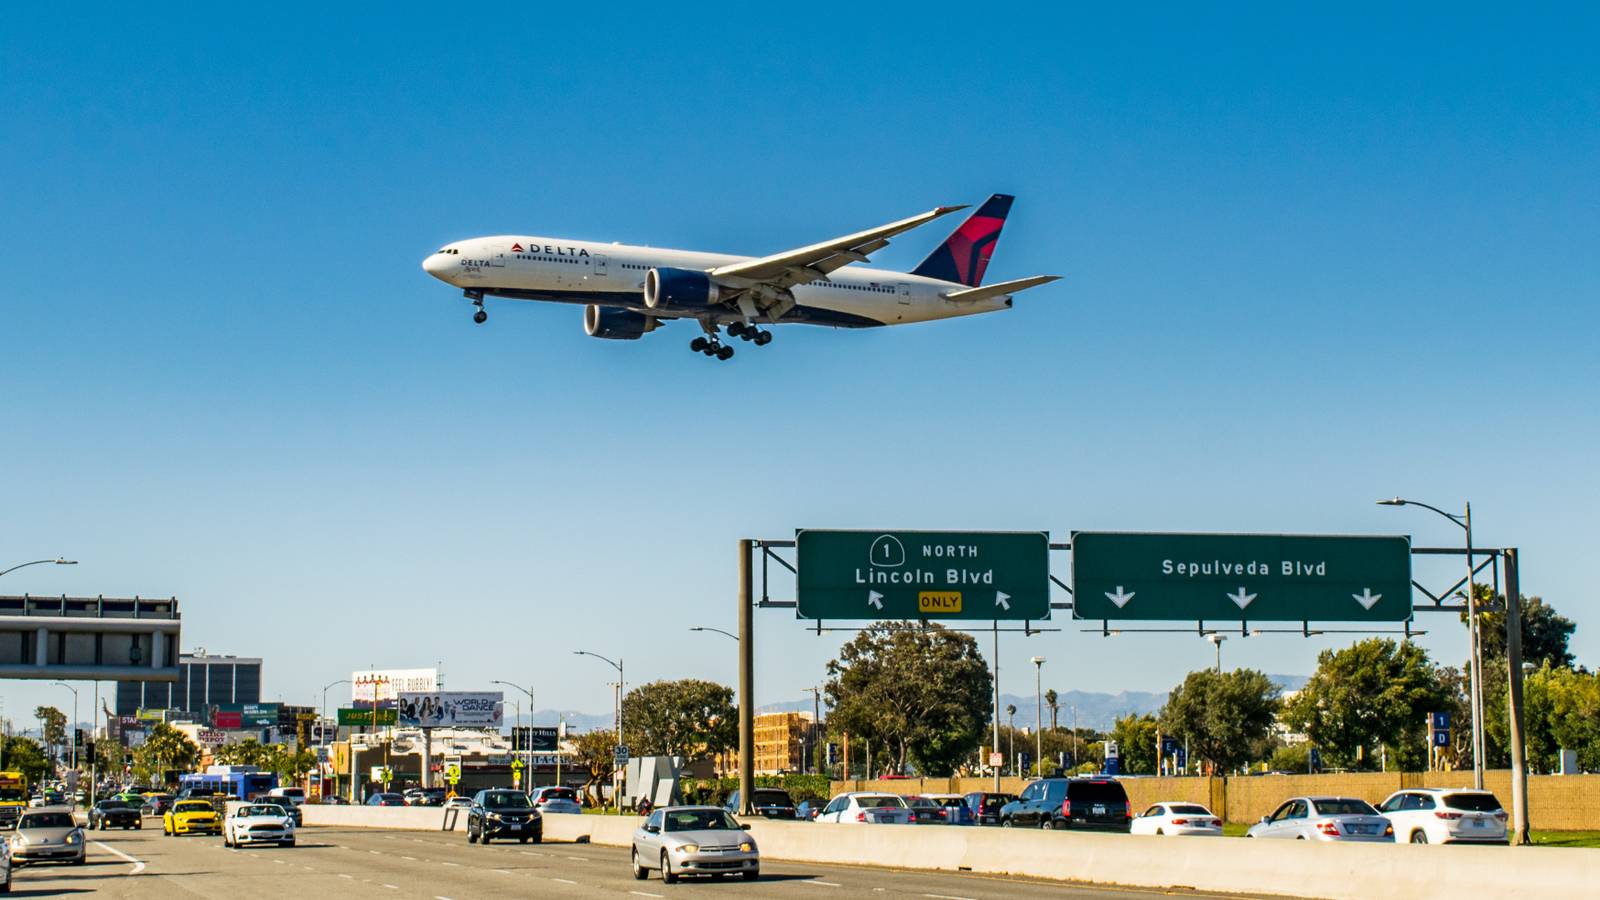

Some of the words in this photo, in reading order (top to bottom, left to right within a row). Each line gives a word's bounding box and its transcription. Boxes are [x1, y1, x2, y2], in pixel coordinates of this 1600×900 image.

[530, 243, 590, 258] DELTA
[460, 259, 490, 268] DELTA
[883, 543, 890, 558] 1
[922, 545, 978, 558] NORTH
[1162, 559, 1269, 577] Sepulveda
[1281, 560, 1326, 576] Blvd
[855, 567, 934, 584] Lincoln
[946, 568, 993, 585] Blvd
[921, 596, 958, 608] ONLY
[1439, 716, 1444, 726] 1
[1438, 733, 1446, 744] D
[615, 746, 628, 755] 30
